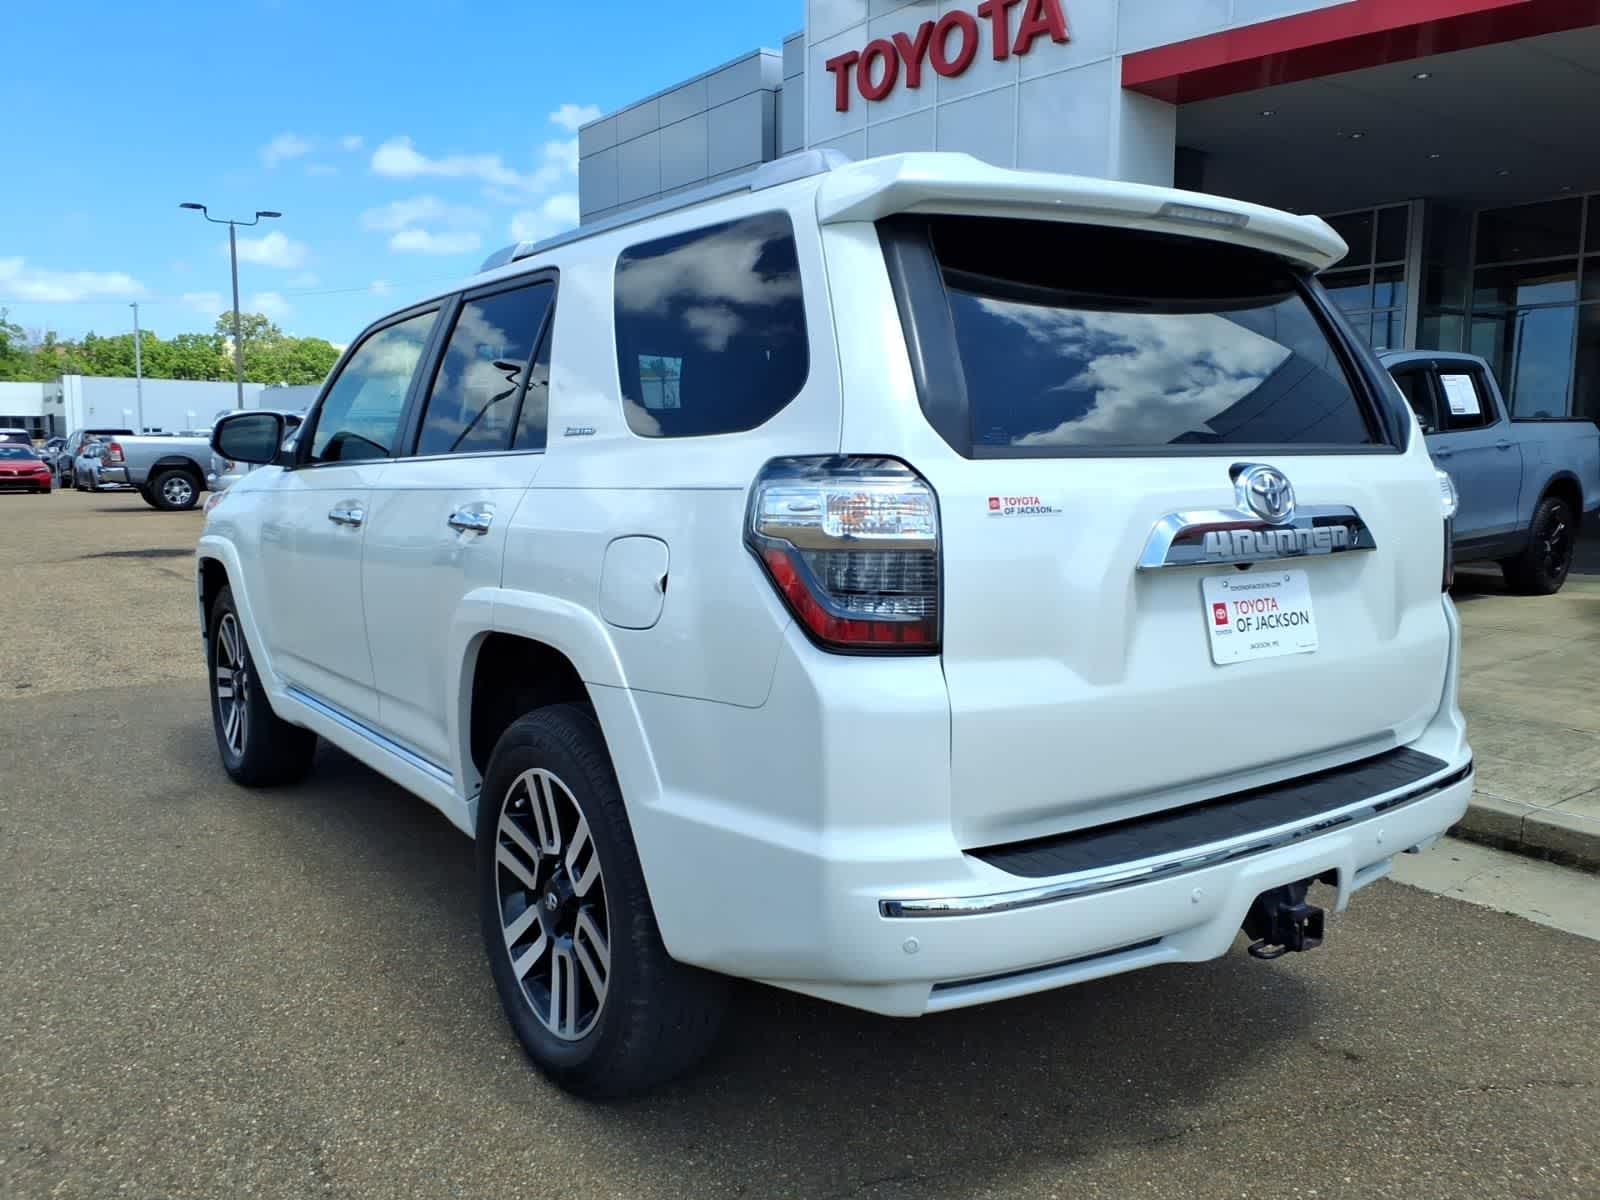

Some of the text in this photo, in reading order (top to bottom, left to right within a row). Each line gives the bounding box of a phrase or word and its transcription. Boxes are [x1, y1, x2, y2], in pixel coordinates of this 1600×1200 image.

[826, 0, 1070, 112] TOYOTA
[1003, 496, 1040, 506] TOYOTA
[1004, 507, 1014, 515] OF
[1017, 506, 1052, 514] JACKSON
[1233, 598, 1279, 615] TOYOTA
[1236, 611, 1310, 632] OF JACKSON
